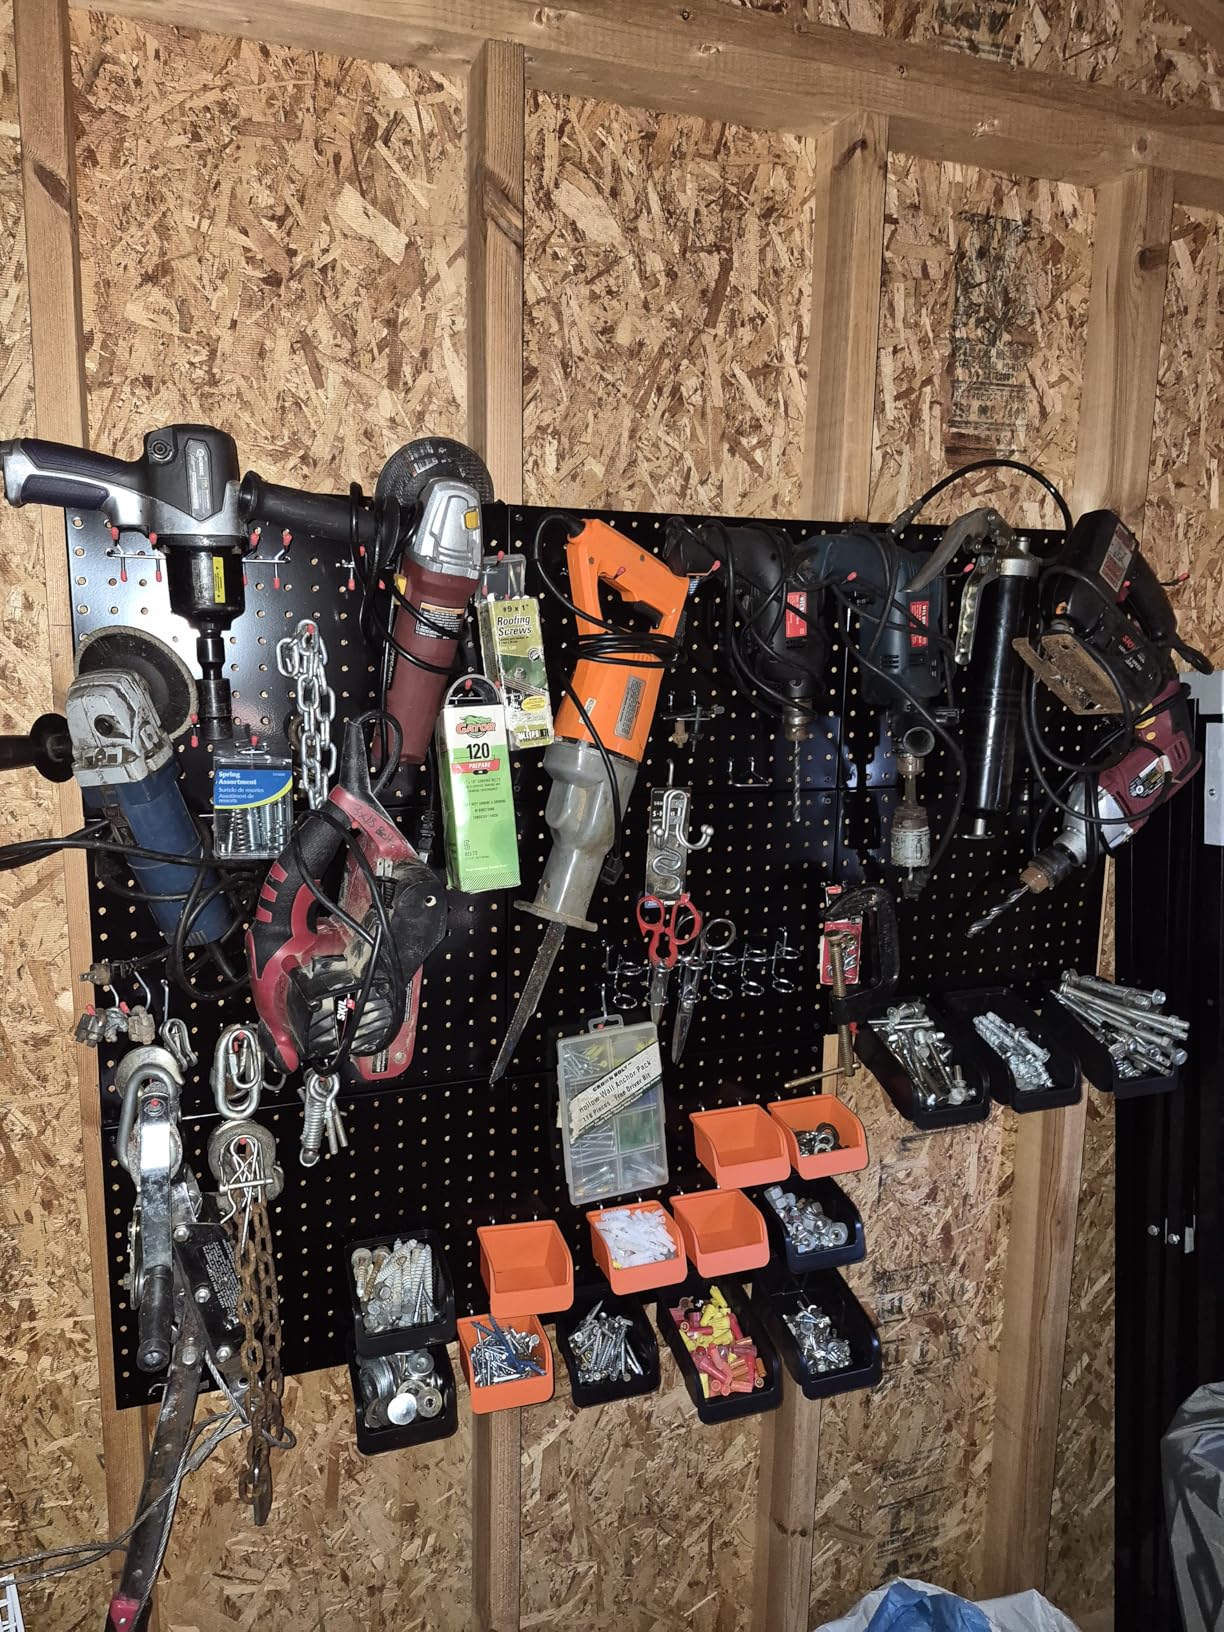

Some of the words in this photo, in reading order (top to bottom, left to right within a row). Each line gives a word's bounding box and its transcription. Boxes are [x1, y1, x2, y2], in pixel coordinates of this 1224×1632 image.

[497, 615, 531, 626] Roofing
[498, 627, 532, 636] Screws
[455, 721, 497, 736] GATOR
[466, 742, 490, 760] 120
[468, 761, 492, 770] PREPARE
[218, 771, 241, 779] Spring
[464, 840, 471, 850] 5
[336, 997, 349, 1022] SKIL
[615, 1071, 636, 1088] Anchor
[636, 1060, 652, 1073] Pack
[593, 1101, 611, 1115] Pieces
[614, 1090, 626, 1101] Free
[626, 1079, 643, 1092] Driver
[642, 1072, 651, 1080] Bit
